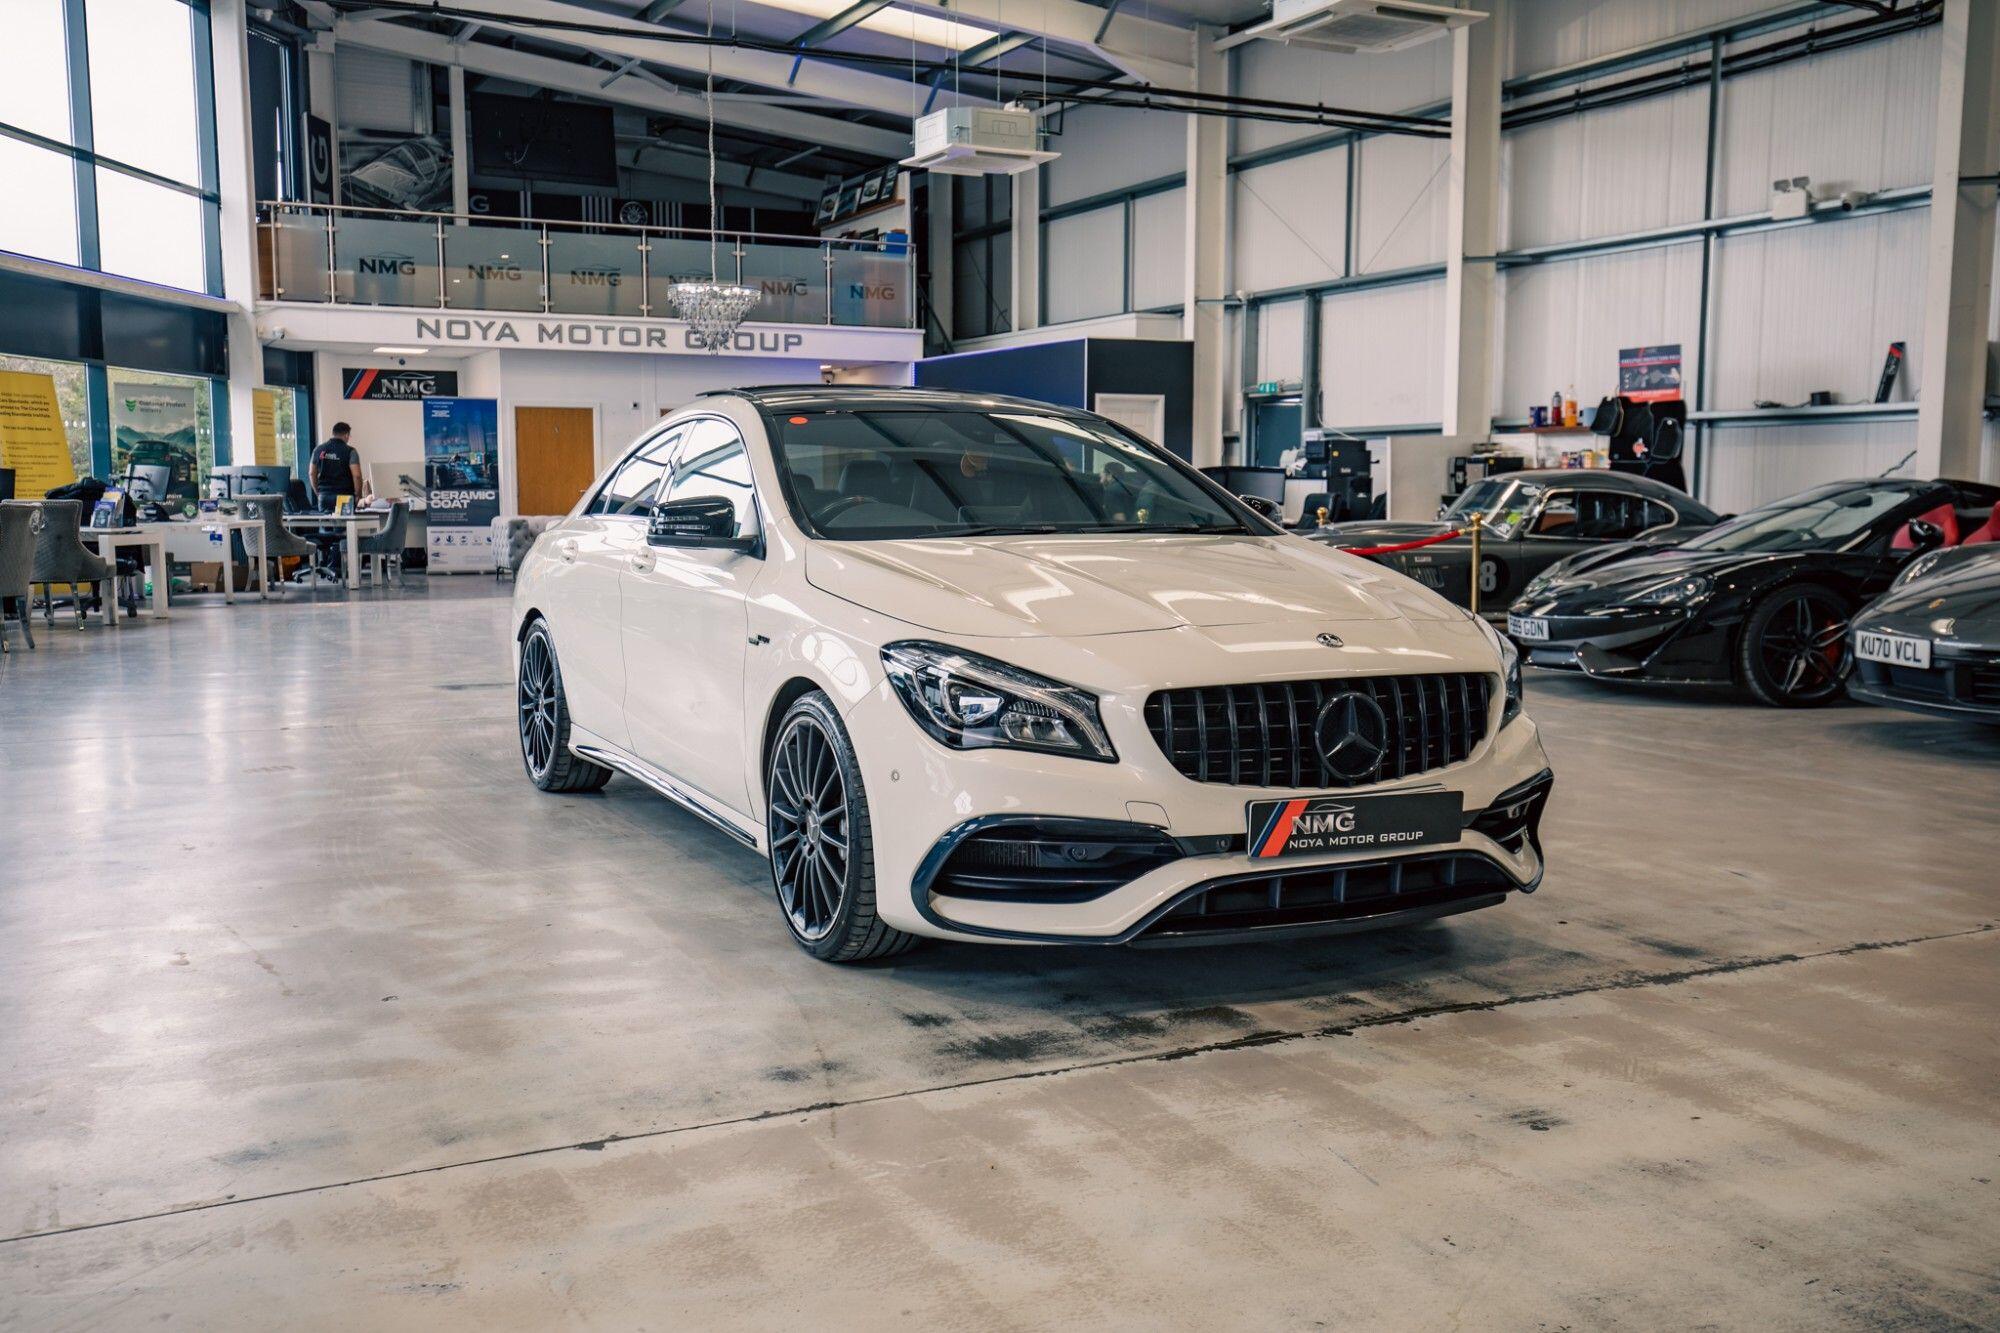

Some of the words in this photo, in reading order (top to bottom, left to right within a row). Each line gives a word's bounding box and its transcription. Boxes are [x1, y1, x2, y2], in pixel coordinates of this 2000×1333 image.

[359, 257, 416, 276] NMG
[467, 263, 522, 281] NMG
[570, 269, 622, 287] NMG
[761, 279, 808, 296] NMG
[849, 285, 896, 300] NMG
[416, 317, 520, 343] NOYA
[537, 323, 667, 348] MOTOR
[381, 378, 437, 395] NMG
[430, 490, 496, 500] CERAMIC
[430, 499, 471, 509] COAT
[1480, 560, 1498, 592] 8
[1860, 634, 1891, 658] KU70
[1895, 640, 1922, 663] VCL
[1290, 812, 1356, 836] NMG
[1288, 839, 1324, 849] NOYA
[1329, 834, 1375, 846] MOTOR
[1379, 831, 1424, 842] GROUP
